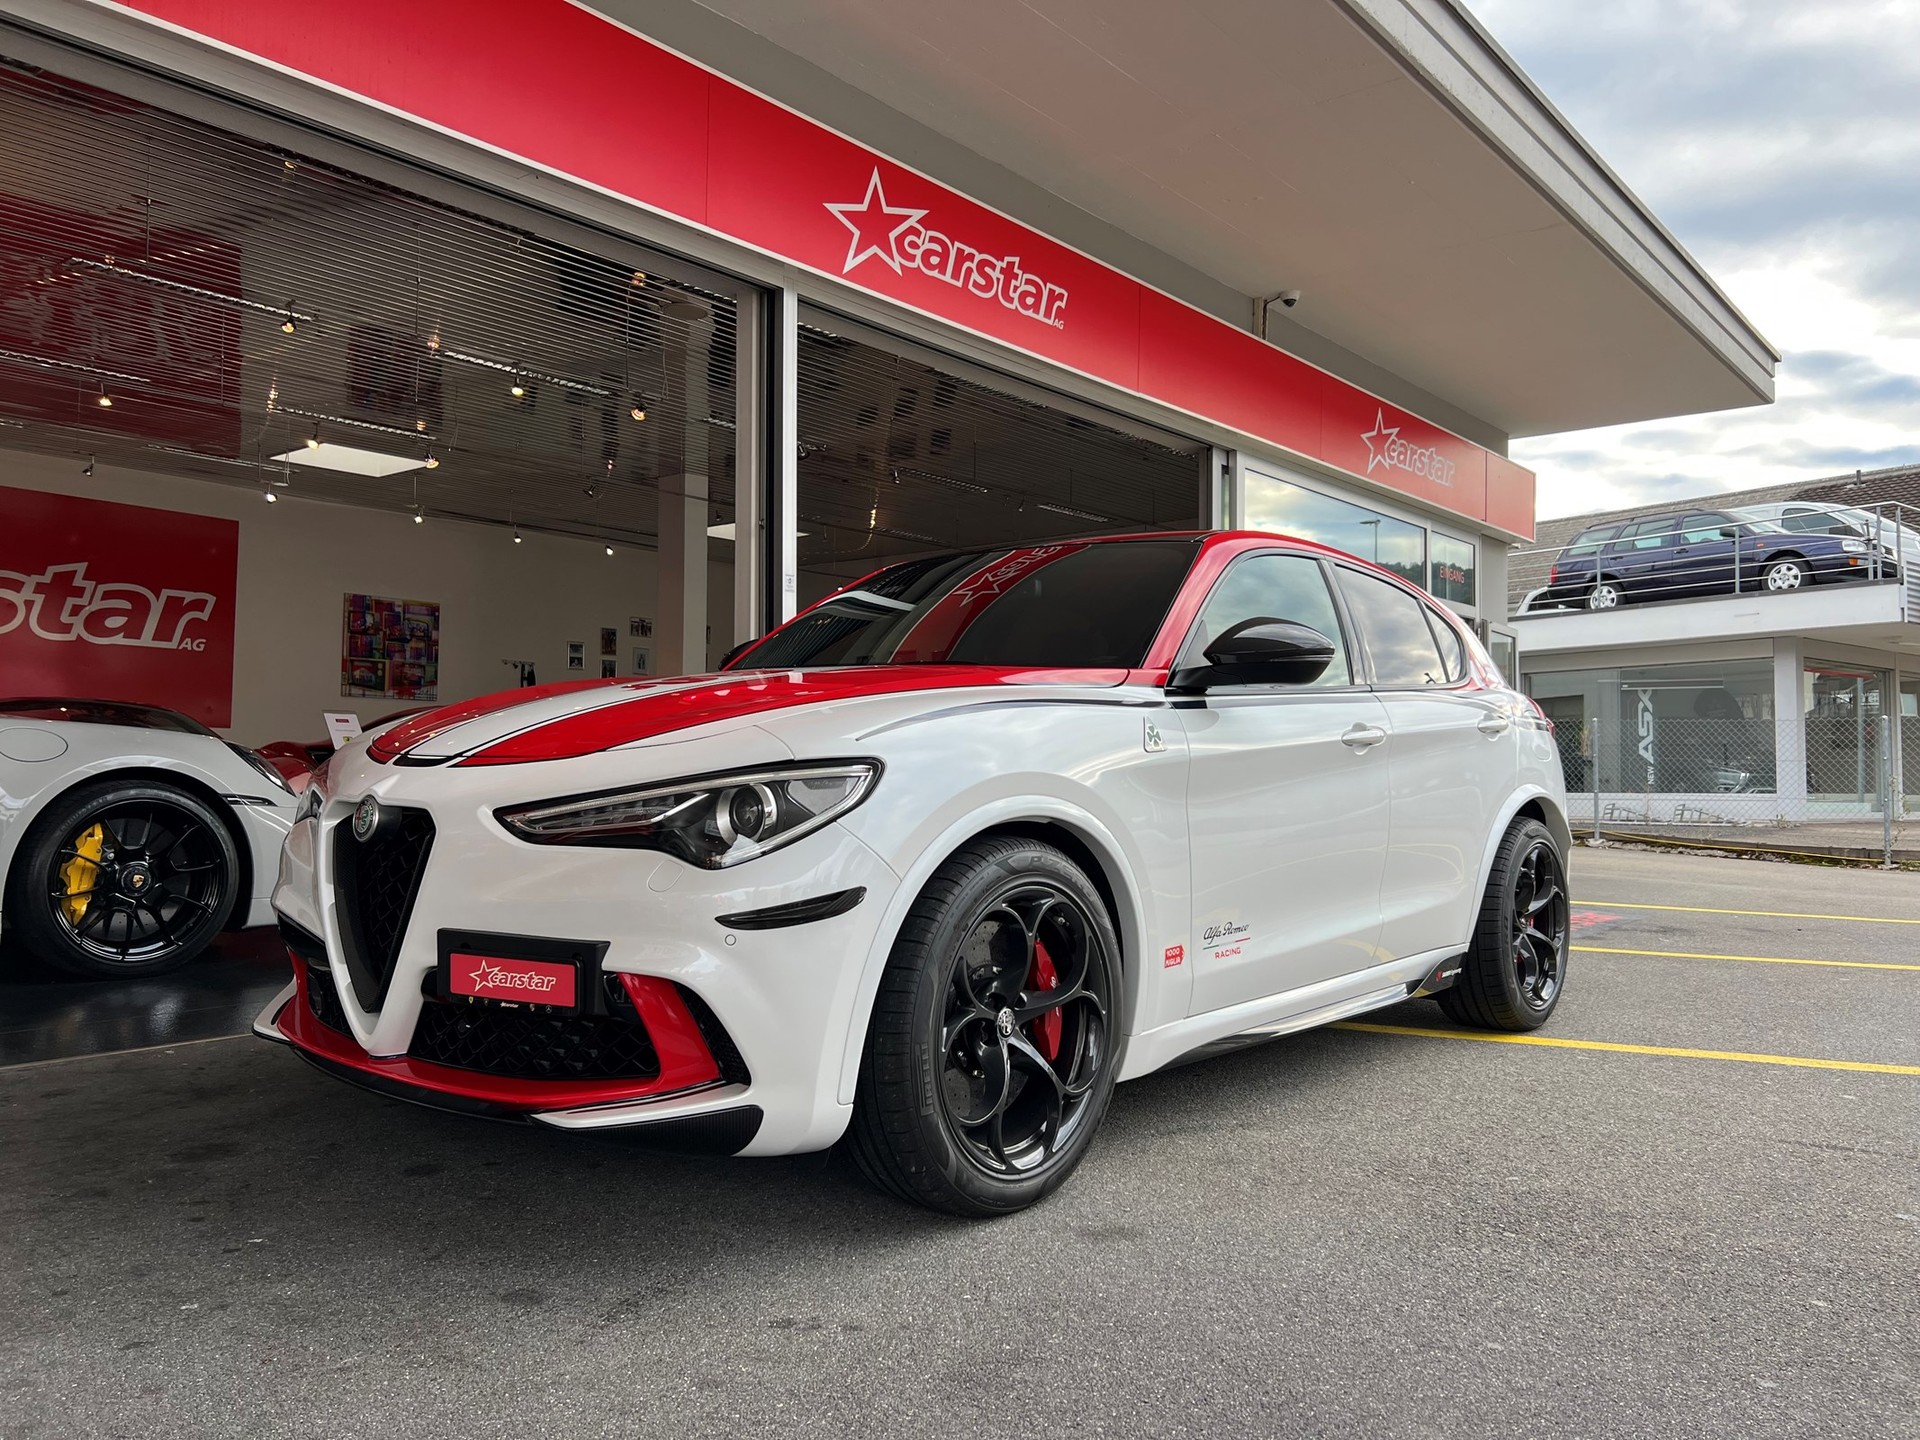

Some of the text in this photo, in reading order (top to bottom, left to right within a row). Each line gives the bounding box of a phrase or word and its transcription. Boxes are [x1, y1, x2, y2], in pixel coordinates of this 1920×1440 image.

[893, 222, 1069, 330] carstar AG
[1386, 436, 1456, 486] carstar
[1440, 565, 1465, 584] EINGANG
[178, 637, 207, 652] AG
[1637, 688, 1655, 785] NEW ASX
[1203, 921, 1250, 945] Alfa Romeo
[1214, 946, 1241, 960] RACING
[489, 970, 557, 992] carstar
[918, 1042, 934, 1117] PIRELLI
